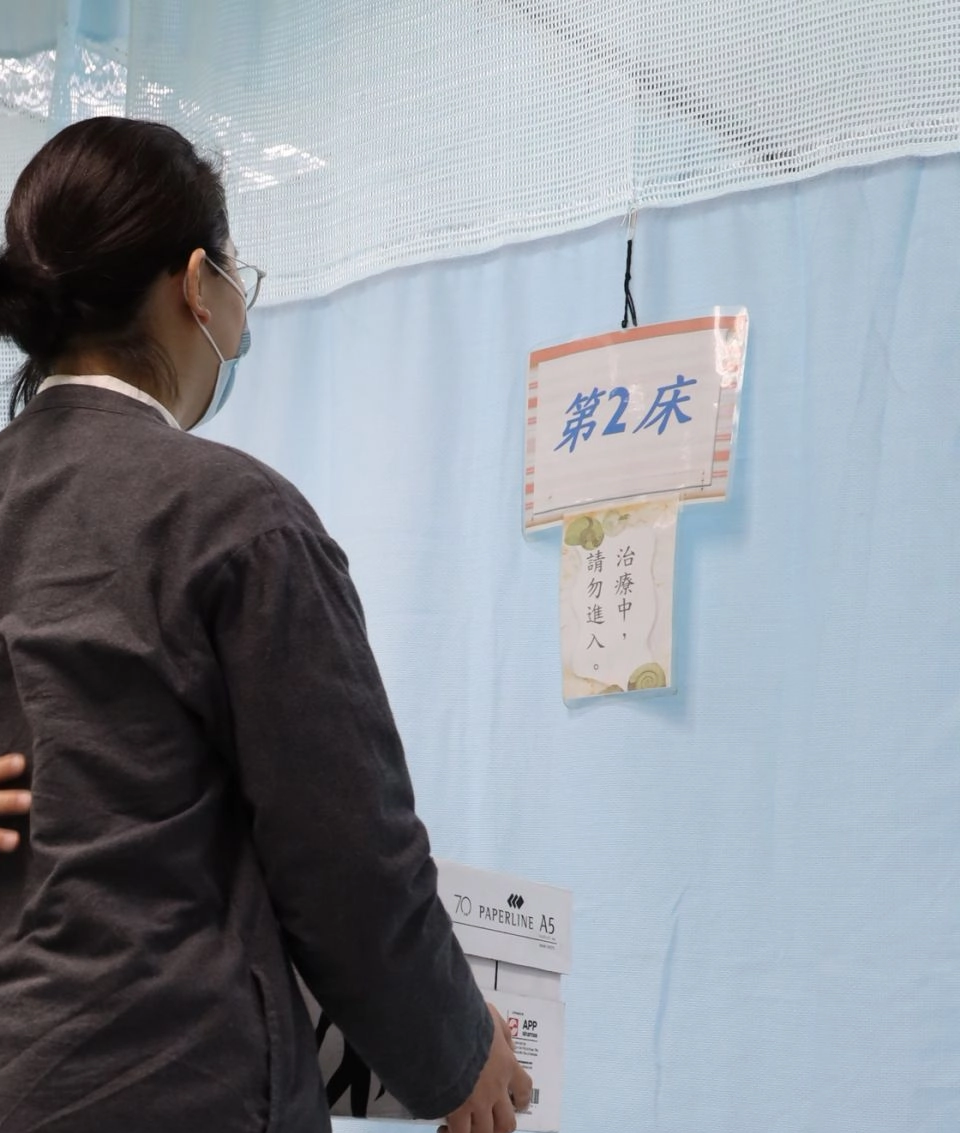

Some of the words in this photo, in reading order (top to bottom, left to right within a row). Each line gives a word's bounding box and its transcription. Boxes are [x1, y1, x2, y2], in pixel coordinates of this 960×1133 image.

[553, 374, 698, 454] 第2床
[453, 894, 472, 916] 70
[479, 905, 534, 930] PAPERLINE
[539, 914, 555, 934] A5
[522, 1019, 538, 1031] APP
